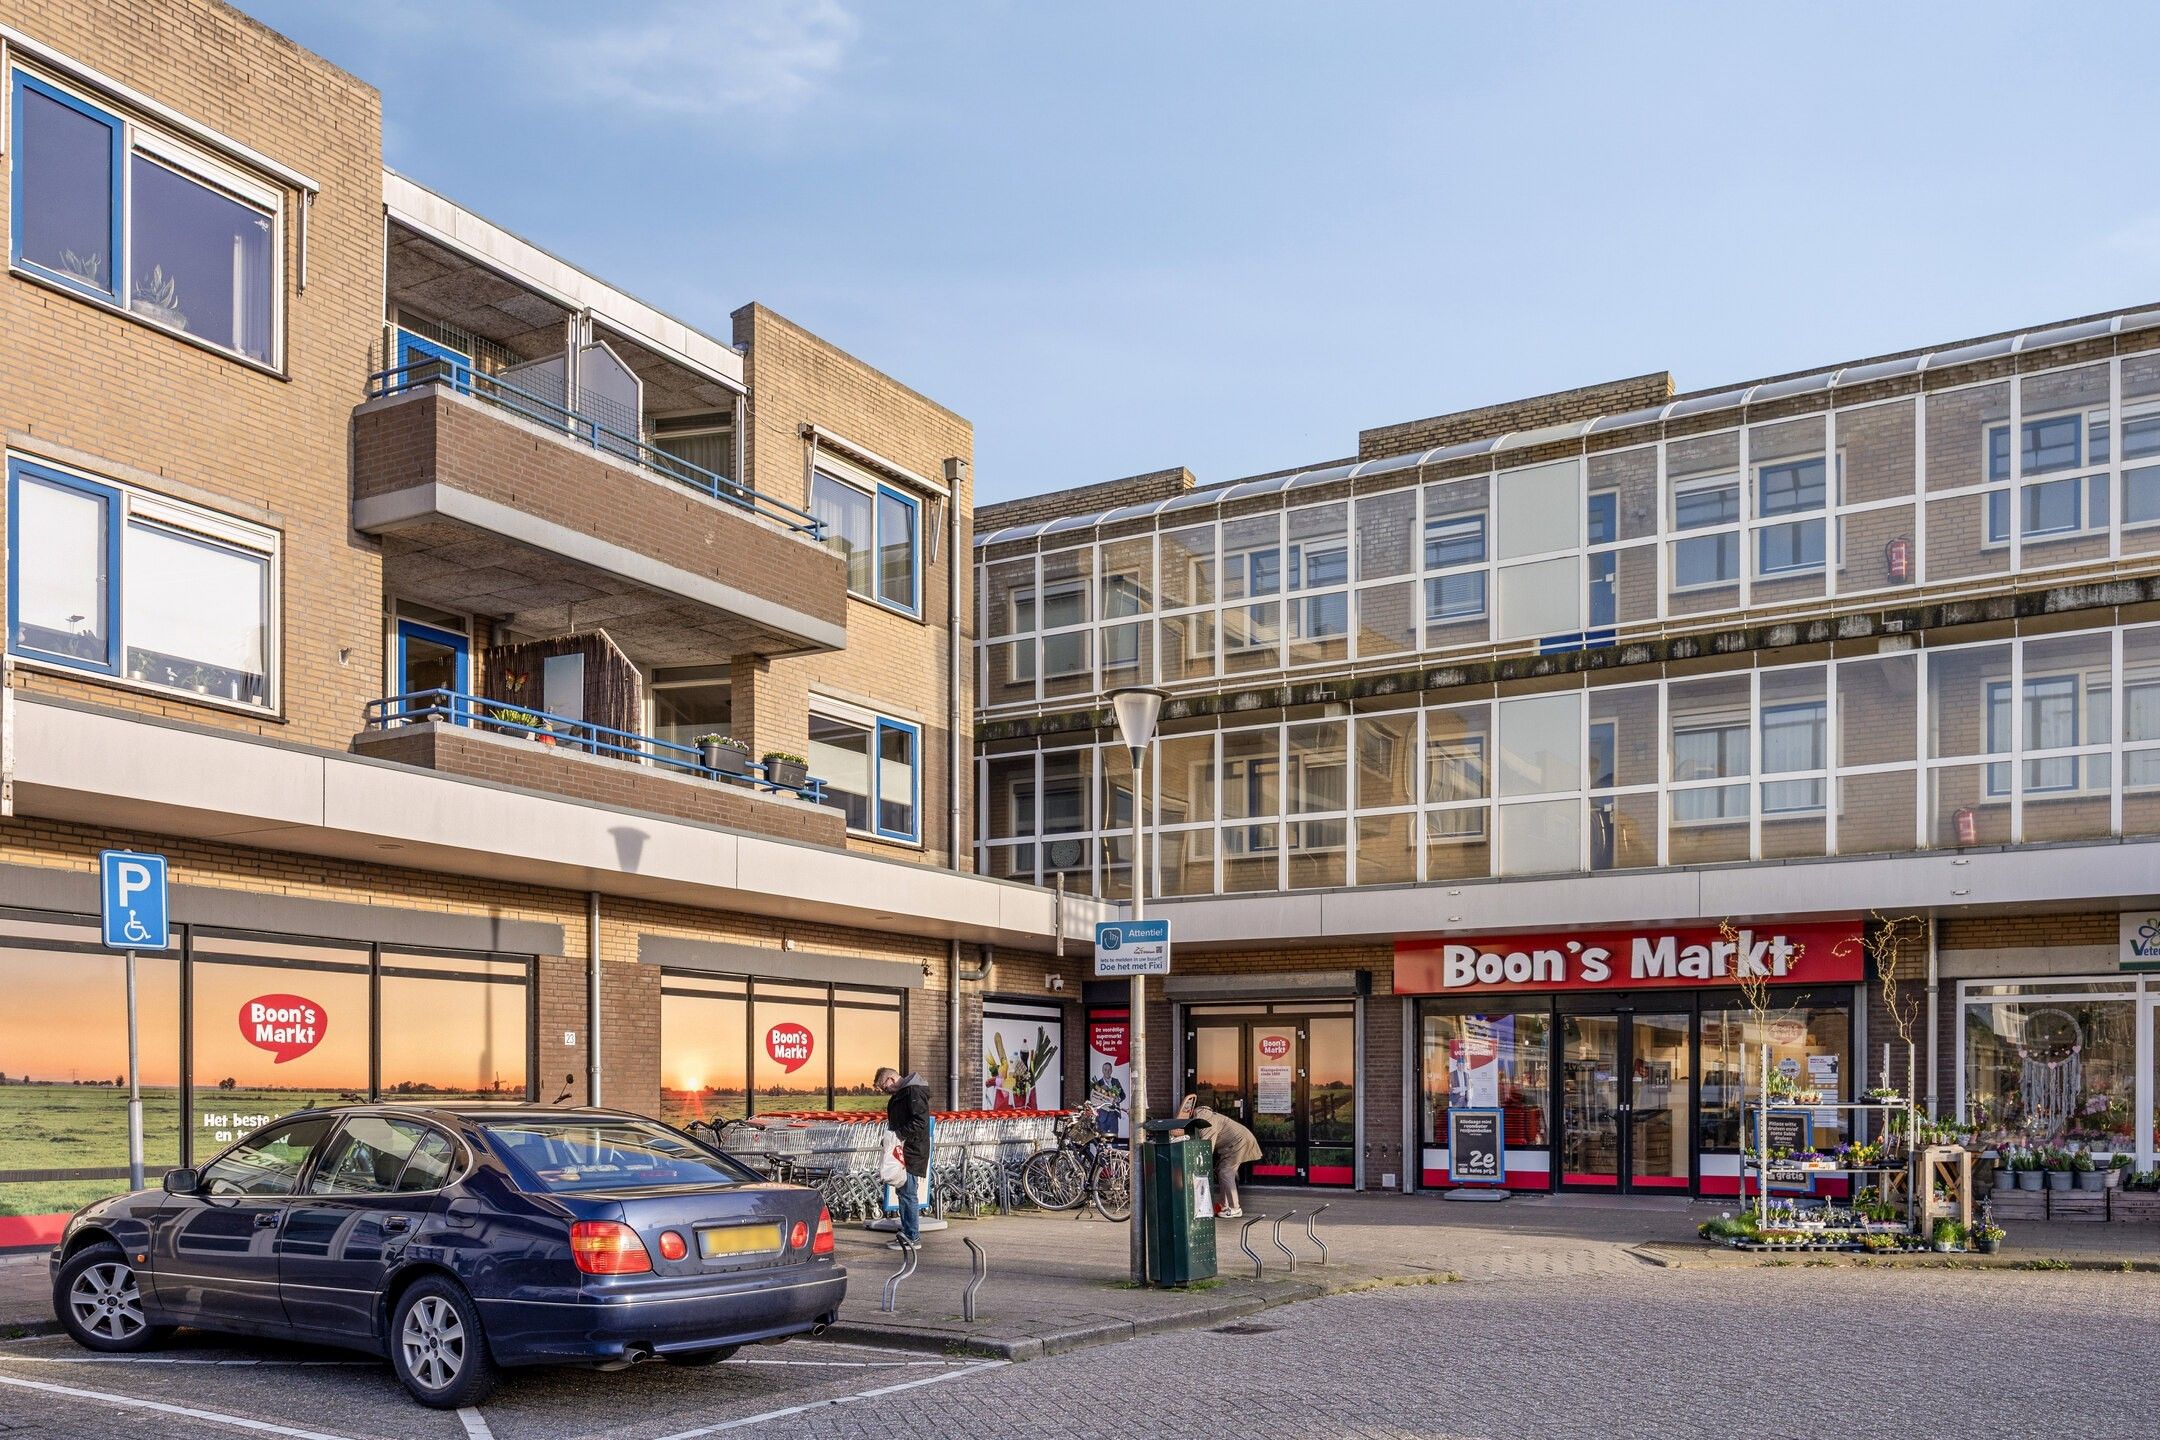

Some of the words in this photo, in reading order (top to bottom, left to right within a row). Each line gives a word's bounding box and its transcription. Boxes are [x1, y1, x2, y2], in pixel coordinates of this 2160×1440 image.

[119, 861, 151, 907] P
[1128, 928, 1163, 937] Attentie!
[2129, 938, 2160, 956] Vete
[1100, 963, 1116, 971] Doe
[1148, 961, 1163, 969] Fixi
[1443, 941, 1611, 988] Boon's
[1631, 930, 1794, 979] Markt
[251, 1003, 316, 1024] Boon's
[255, 1024, 316, 1044] Markt
[772, 1029, 808, 1045] Boon's
[1262, 1039, 1287, 1047] Boon's
[1264, 1046, 1286, 1054] Markt
[774, 1044, 808, 1059] Markt
[204, 1113, 228, 1127] Het
[233, 1113, 270, 1127] beste
[215, 1130, 232, 1142] en
[1469, 1150, 1495, 1168] 2e
[1776, 1171, 1805, 1180] gratis
